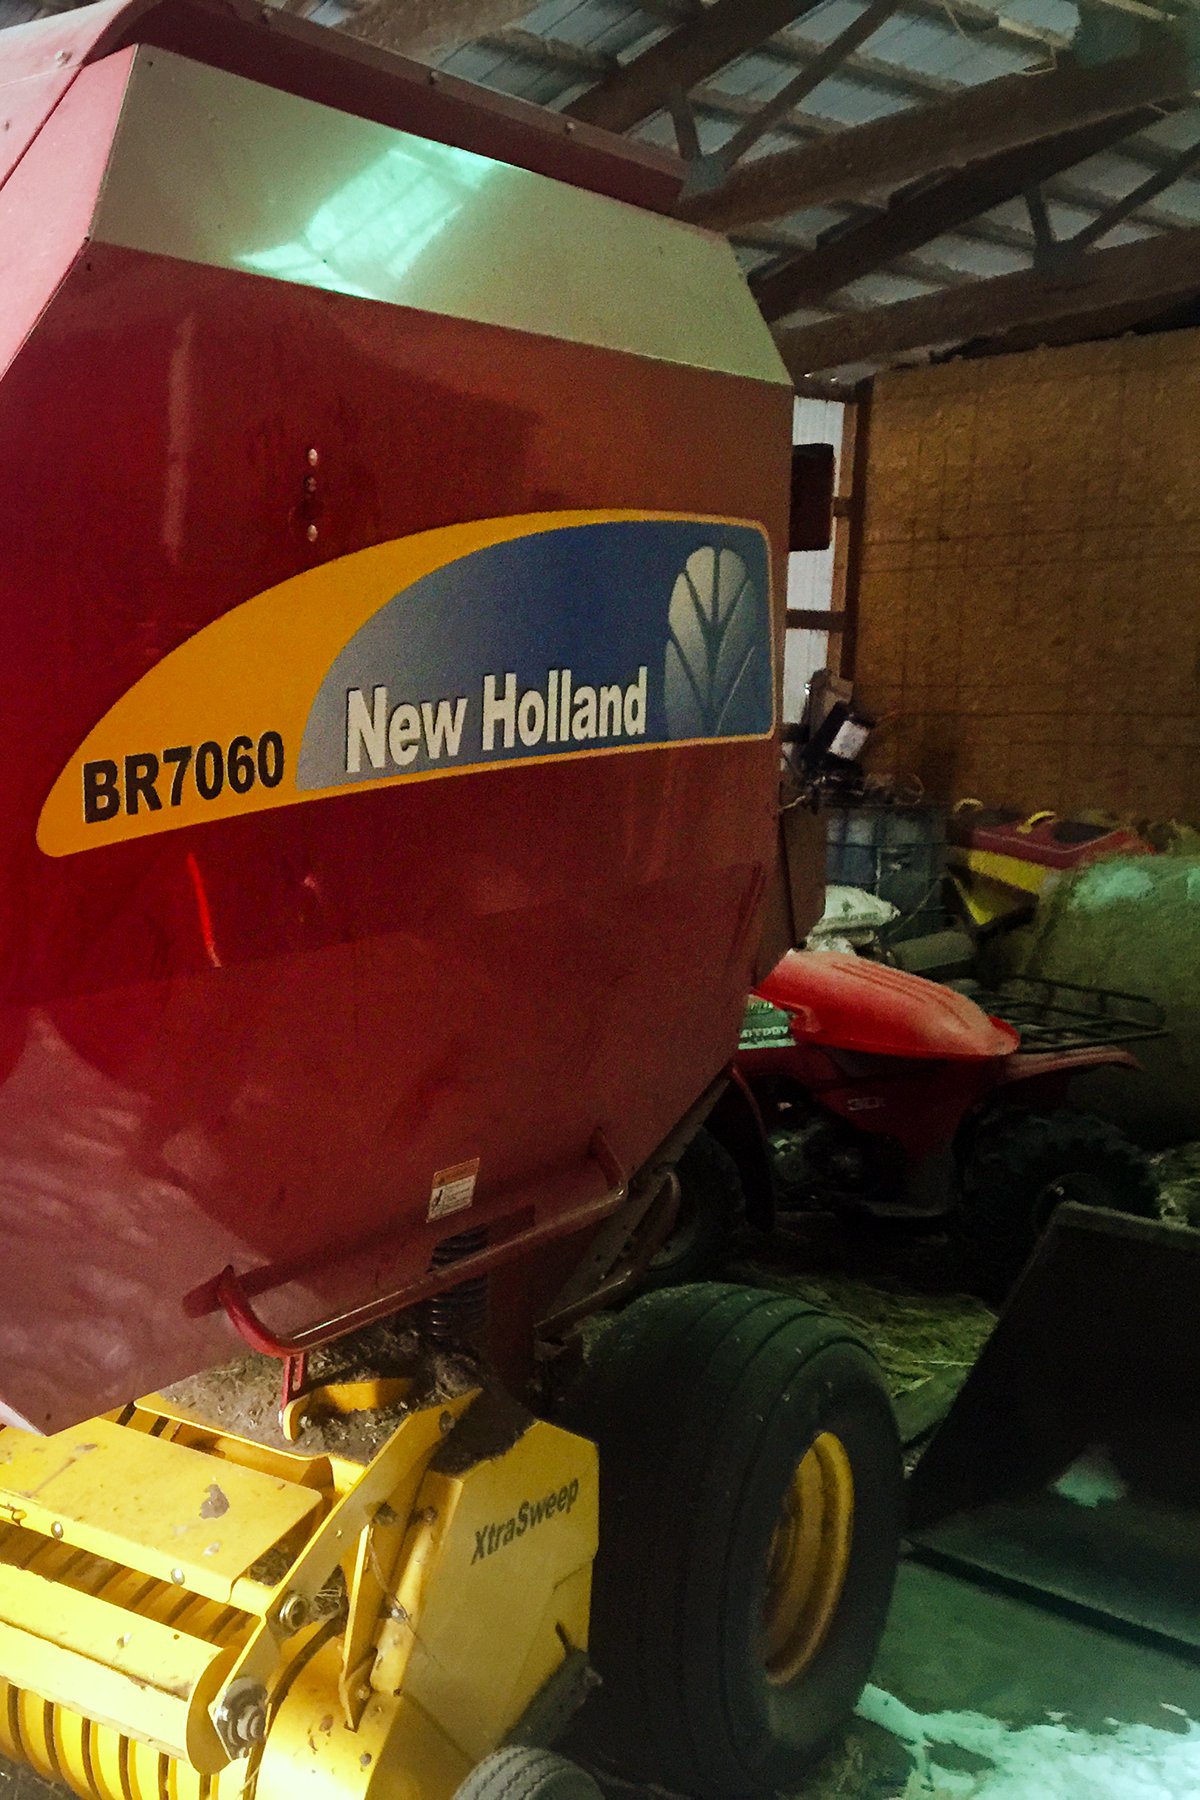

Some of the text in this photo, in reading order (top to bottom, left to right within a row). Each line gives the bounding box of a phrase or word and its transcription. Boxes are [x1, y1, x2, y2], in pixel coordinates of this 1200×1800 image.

[346, 665, 648, 773] New Holland
[83, 731, 285, 824] BR7060
[471, 1478, 579, 1566] XtraSweep
